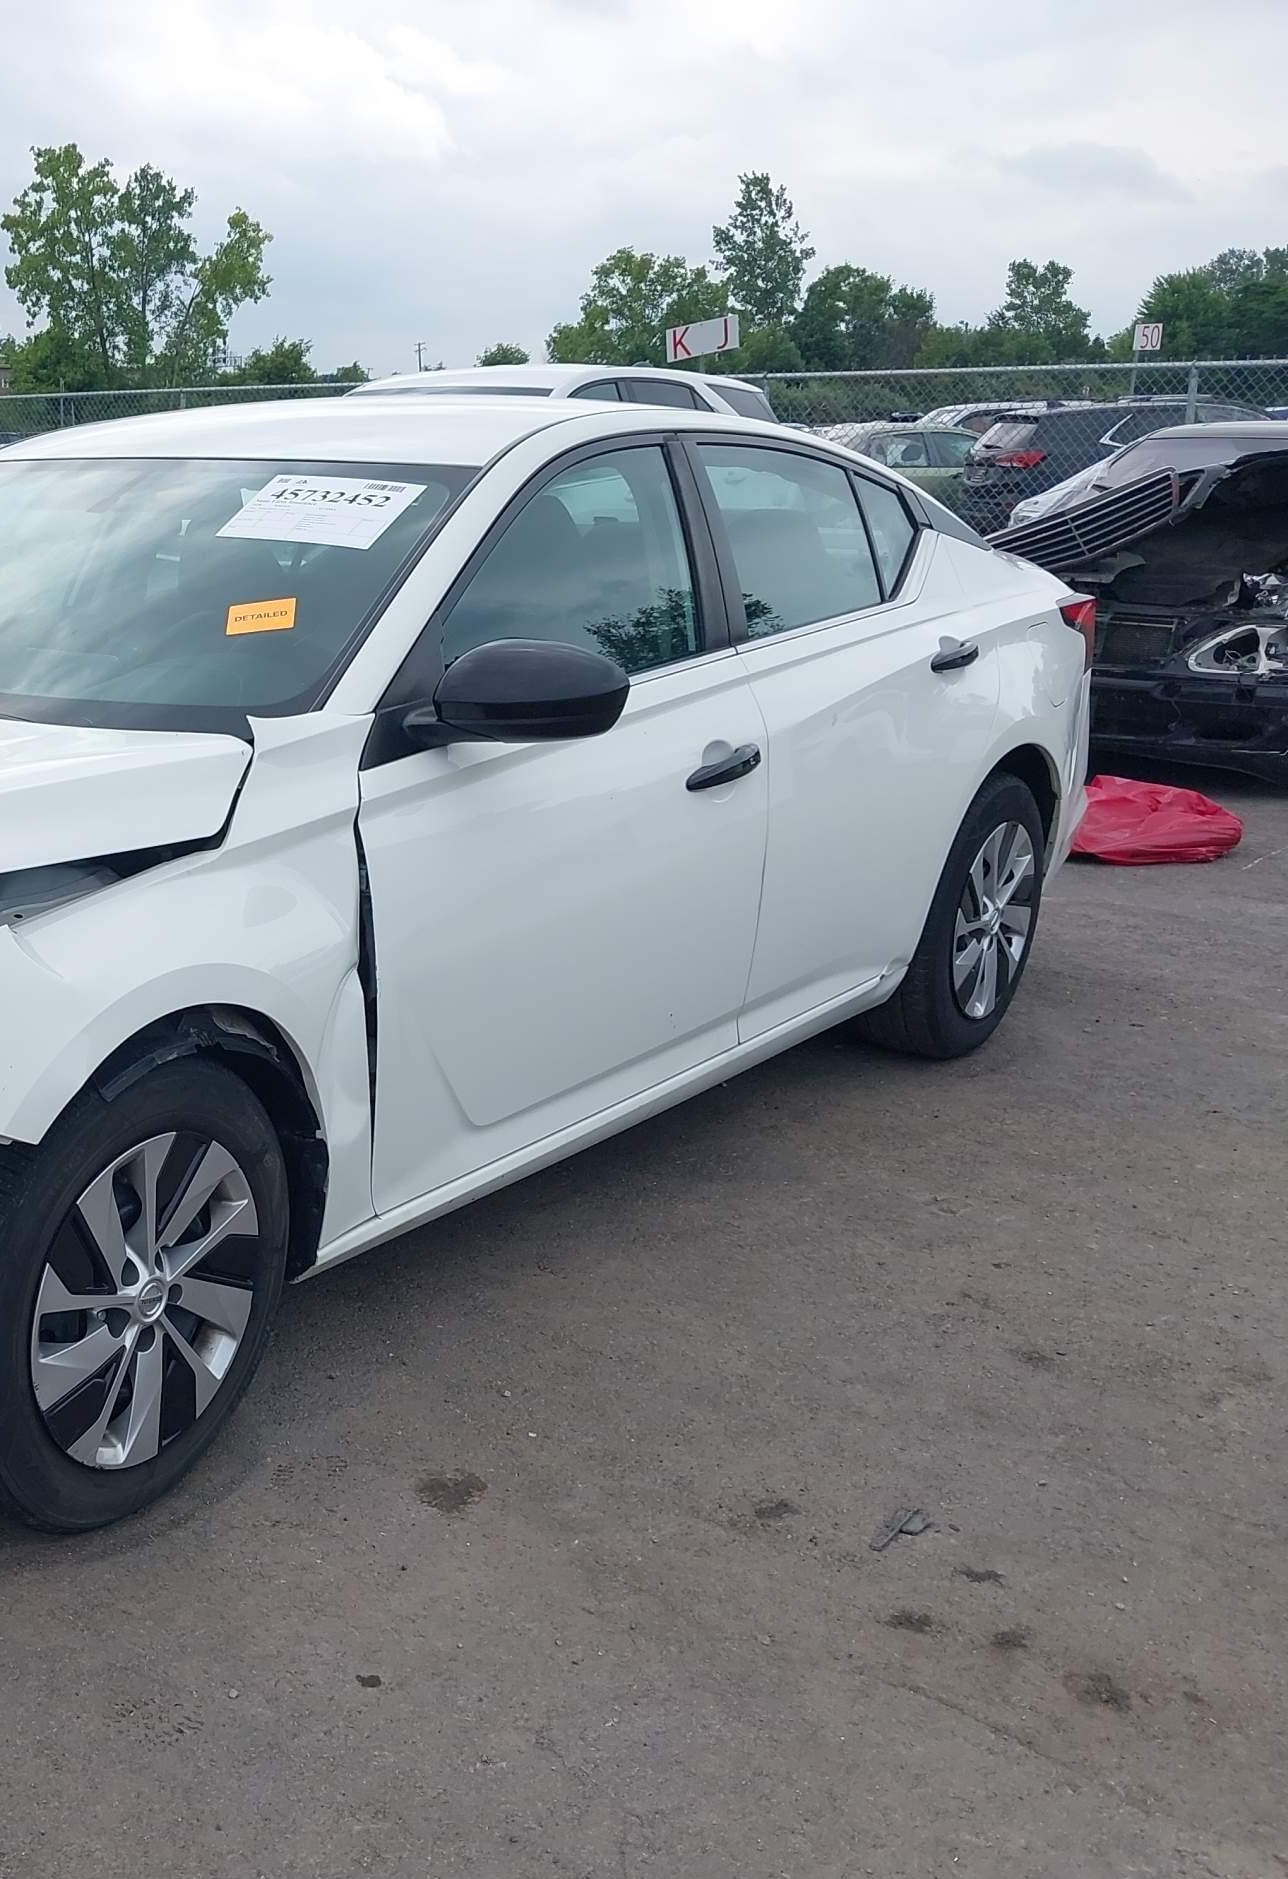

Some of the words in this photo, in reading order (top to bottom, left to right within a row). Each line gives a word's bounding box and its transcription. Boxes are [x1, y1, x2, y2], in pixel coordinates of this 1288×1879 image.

[672, 326, 692, 360] K
[716, 318, 729, 350] J
[1139, 325, 1161, 349] 50
[270, 487, 392, 508] 45732452
[234, 610, 288, 622] DETAILED
